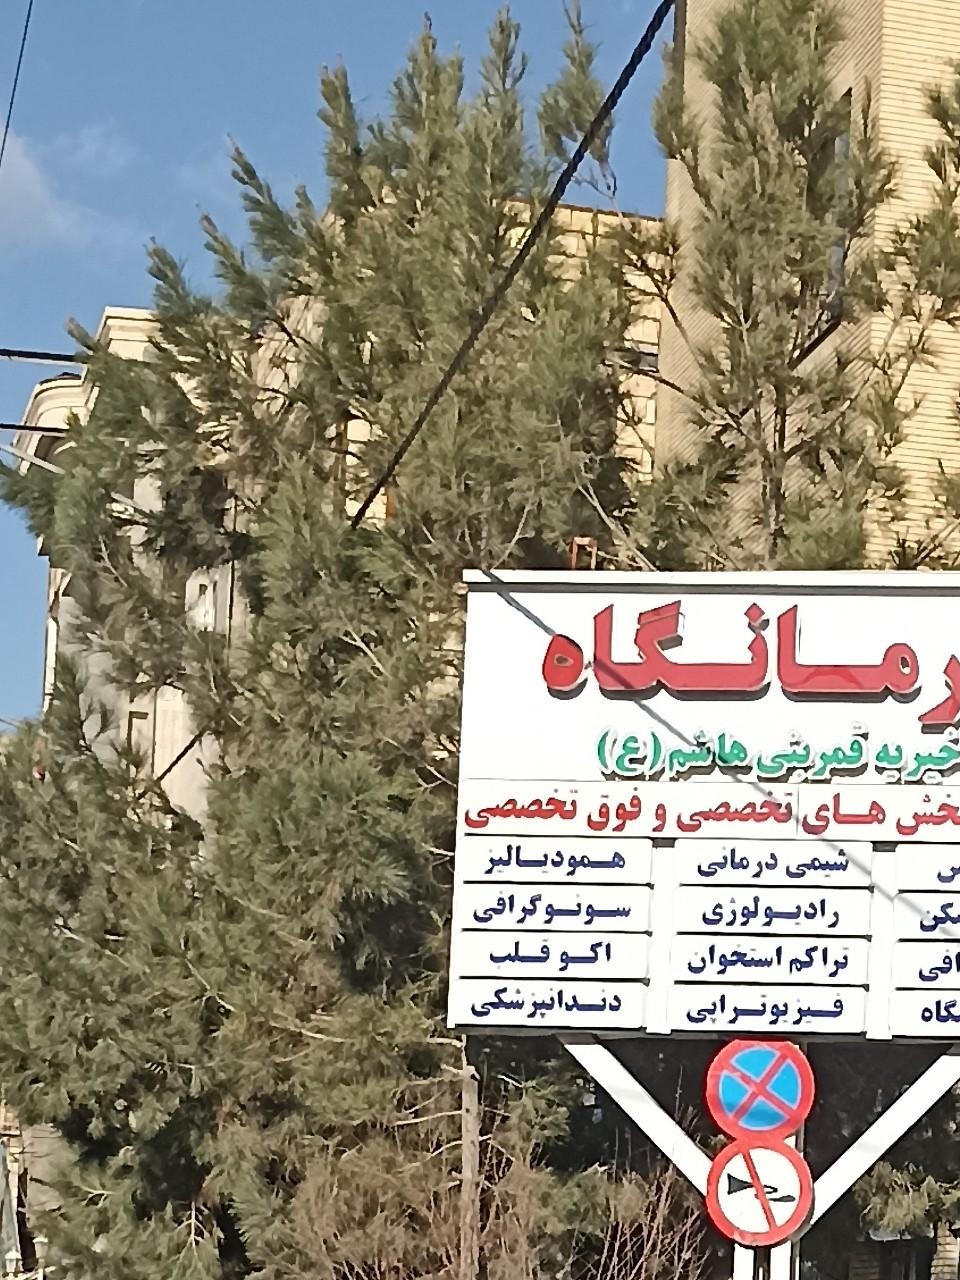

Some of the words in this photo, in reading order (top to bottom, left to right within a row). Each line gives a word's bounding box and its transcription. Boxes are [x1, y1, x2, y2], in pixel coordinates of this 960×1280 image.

[597, 728, 663, 776] (ع)
[668, 729, 752, 778] هاشم
[464, 788, 579, 828] تخصصی
[587, 786, 642, 832] فوق
[652, 802, 667, 833] و
[676, 790, 793, 833] تخصصی
[802, 792, 887, 836] های
[484, 844, 626, 876] همودیالیز
[697, 846, 778, 878] درمانی
[786, 849, 849, 878] شیمی
[473, 891, 631, 925] سونوگرافی
[702, 896, 839, 928] رادیولوژی
[490, 938, 550, 969] قلب
[559, 942, 611, 971] اکو
[687, 944, 783, 975] استخوان
[789, 945, 849, 977] تراکم
[471, 987, 622, 1018] دندانپزشکی
[686, 993, 843, 1025] فیزیوتراپی
